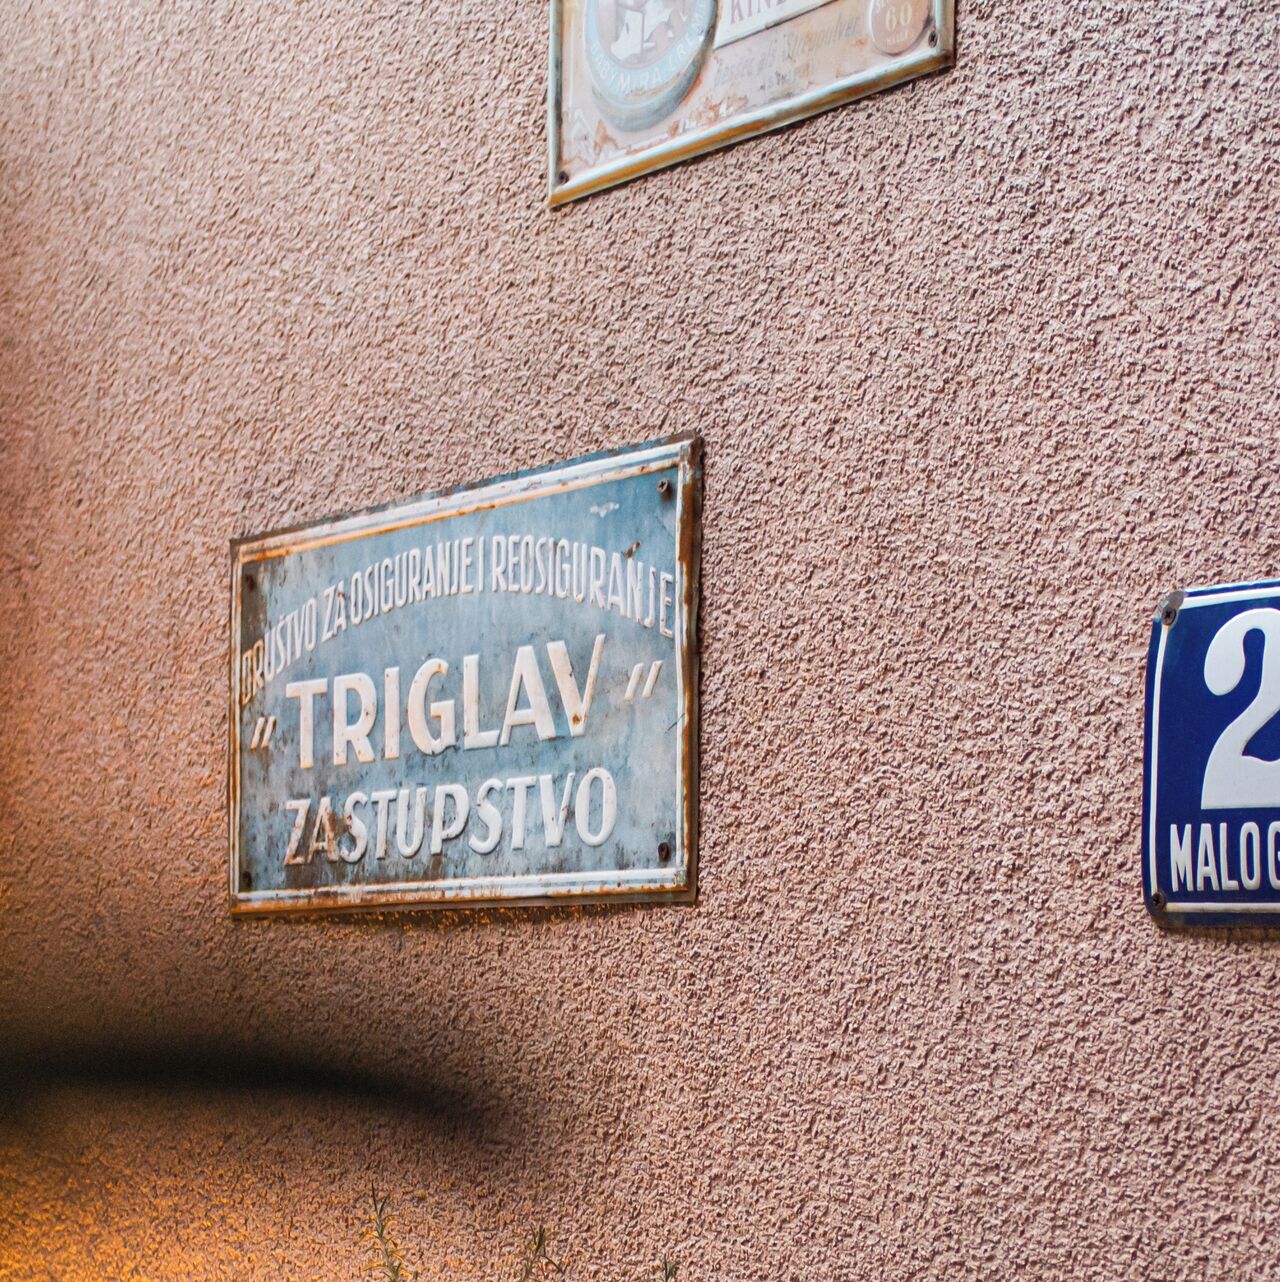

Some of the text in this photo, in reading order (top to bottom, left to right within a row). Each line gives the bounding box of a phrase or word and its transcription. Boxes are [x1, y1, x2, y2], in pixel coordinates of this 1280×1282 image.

[321, 579, 349, 643] ZA
[349, 536, 476, 626] OSIGURANJE
[477, 535, 487, 593] I
[490, 535, 676, 640] REOSIGURANJE
[283, 766, 620, 867] ZASTUPSTVO
